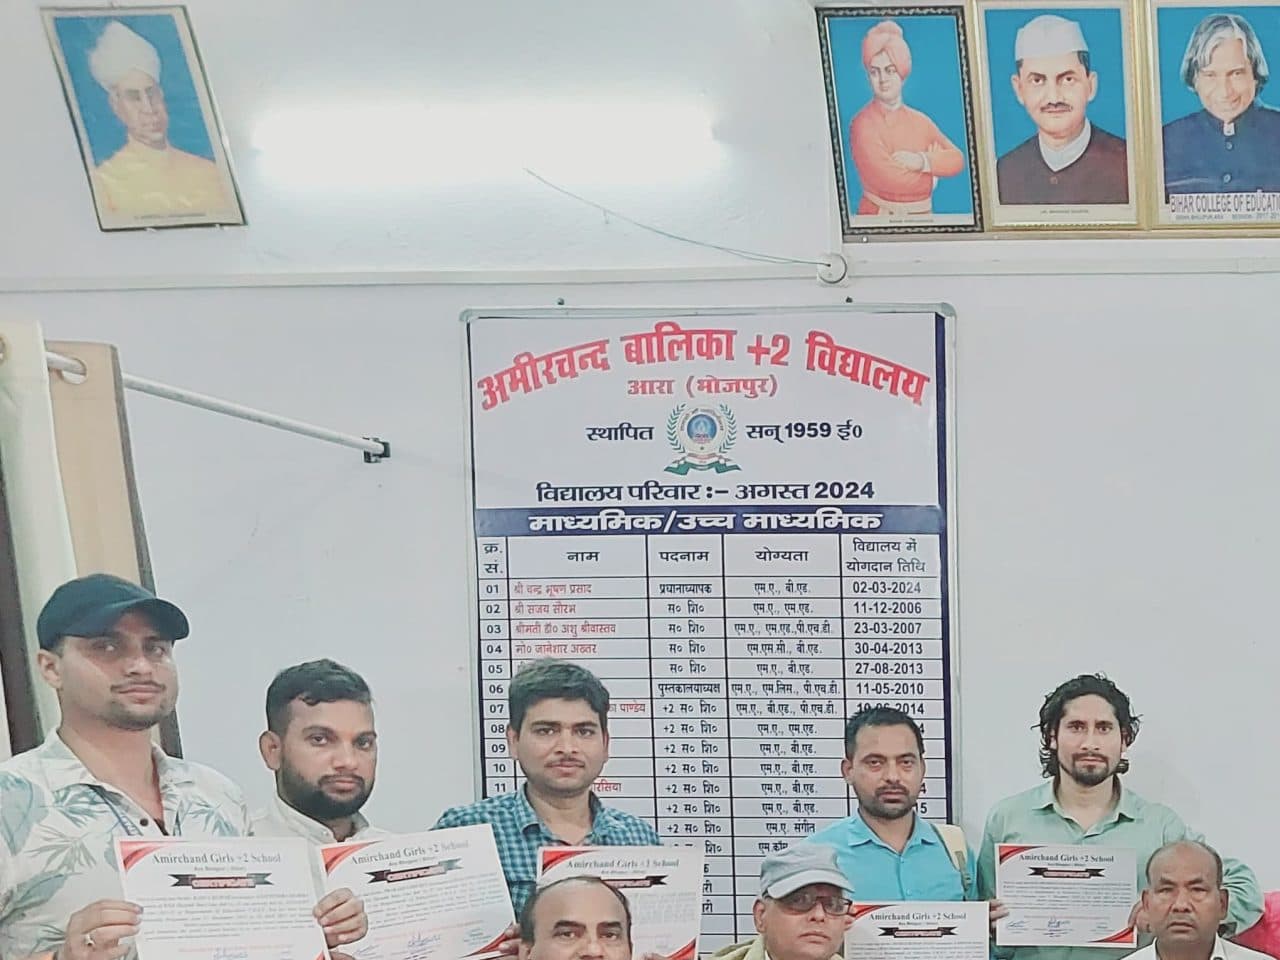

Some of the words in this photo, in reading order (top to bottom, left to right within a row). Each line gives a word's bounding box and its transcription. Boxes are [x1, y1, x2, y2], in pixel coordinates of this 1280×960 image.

[1171, 194, 1194, 212] BIHAR
[1196, 194, 1231, 212] COLLEGE
[1233, 194, 1244, 212] OF
[477, 338, 611, 412] अमीरचन्द
[619, 321, 738, 366] बालिका
[746, 333, 791, 368] +2
[805, 330, 931, 406] विद्यालय
[627, 378, 675, 397] आरा
[586, 421, 654, 443] स्थापित
[784, 422, 832, 440] 1959
[536, 481, 620, 504] विद्यालय
[627, 480, 701, 502] परिवार
[735, 483, 809, 501] अगस्त
[813, 481, 875, 500] 2024
[742, 507, 882, 530] माध्यमिक
[852, 538, 901, 553] विद्यालय
[566, 551, 600, 562] नाम
[659, 551, 710, 562] पदनाम
[755, 547, 809, 562] योग्यता
[846, 558, 892, 573] योगदान
[486, 585, 499, 595] 01
[853, 582, 922, 594] 02-03-2024
[486, 604, 501, 614] 02
[854, 602, 922, 614] 11-12-2006
[487, 624, 502, 634] 03
[854, 622, 922, 634] 23-03-2007
[486, 644, 502, 653] 04
[855, 642, 923, 655] 30-04-2013
[488, 664, 503, 674] 05
[855, 662, 923, 674] 27-08-2013
[489, 684, 504, 694] 06
[856, 683, 924, 695] 11-05-2010
[489, 704, 504, 714] 07
[662, 704, 675, 714] +2
[490, 724, 505, 734] 08
[663, 724, 675, 734] +2
[491, 744, 506, 754] 09
[664, 744, 676, 754] +2
[493, 763, 506, 773] 10
[665, 764, 677, 774] +2
[494, 783, 506, 793] 11
[665, 784, 678, 794] +2
[666, 804, 678, 814] +2
[667, 824, 679, 834] +2
